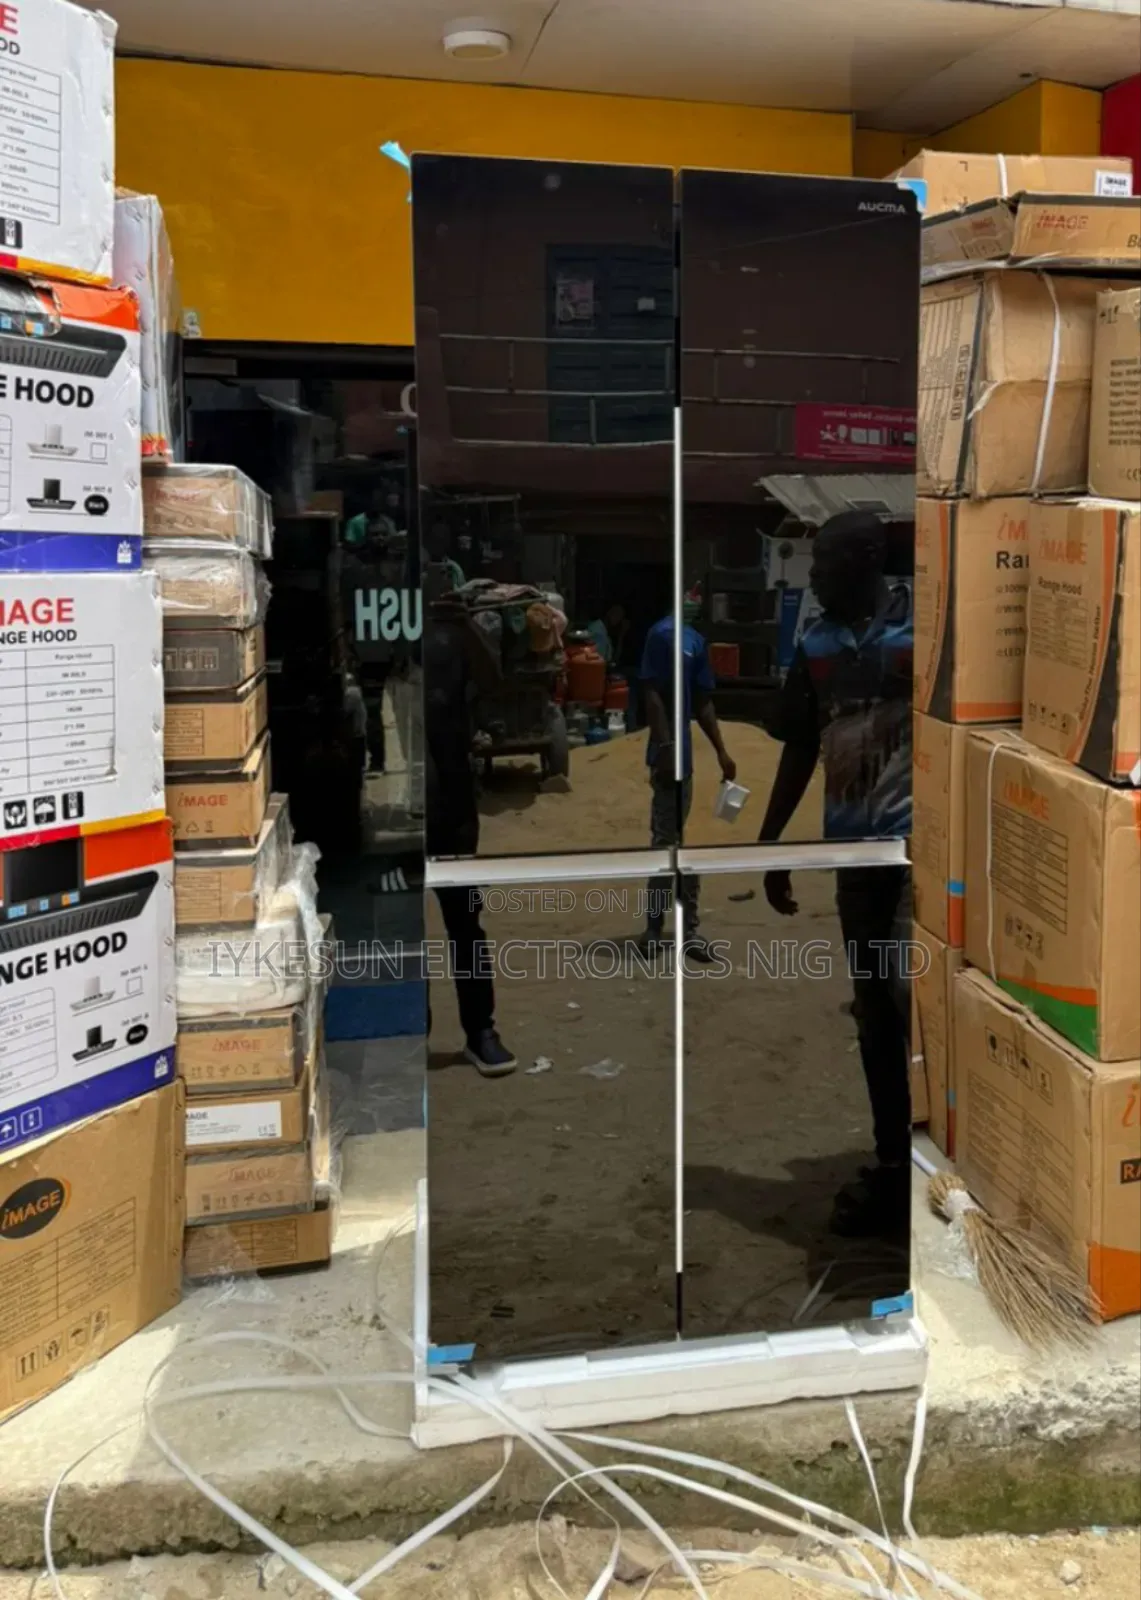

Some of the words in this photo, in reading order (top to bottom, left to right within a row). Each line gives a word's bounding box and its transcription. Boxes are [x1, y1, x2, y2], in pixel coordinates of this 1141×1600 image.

[858, 201, 906, 214] AUCMA
[15, 376, 94, 408] HOOD
[0, 597, 75, 627] AGE
[32, 628, 78, 643] HOOD
[176, 791, 229, 807] iMAGE
[55, 930, 128, 970] HOOD
[1, 1189, 61, 1231] iMAGE
